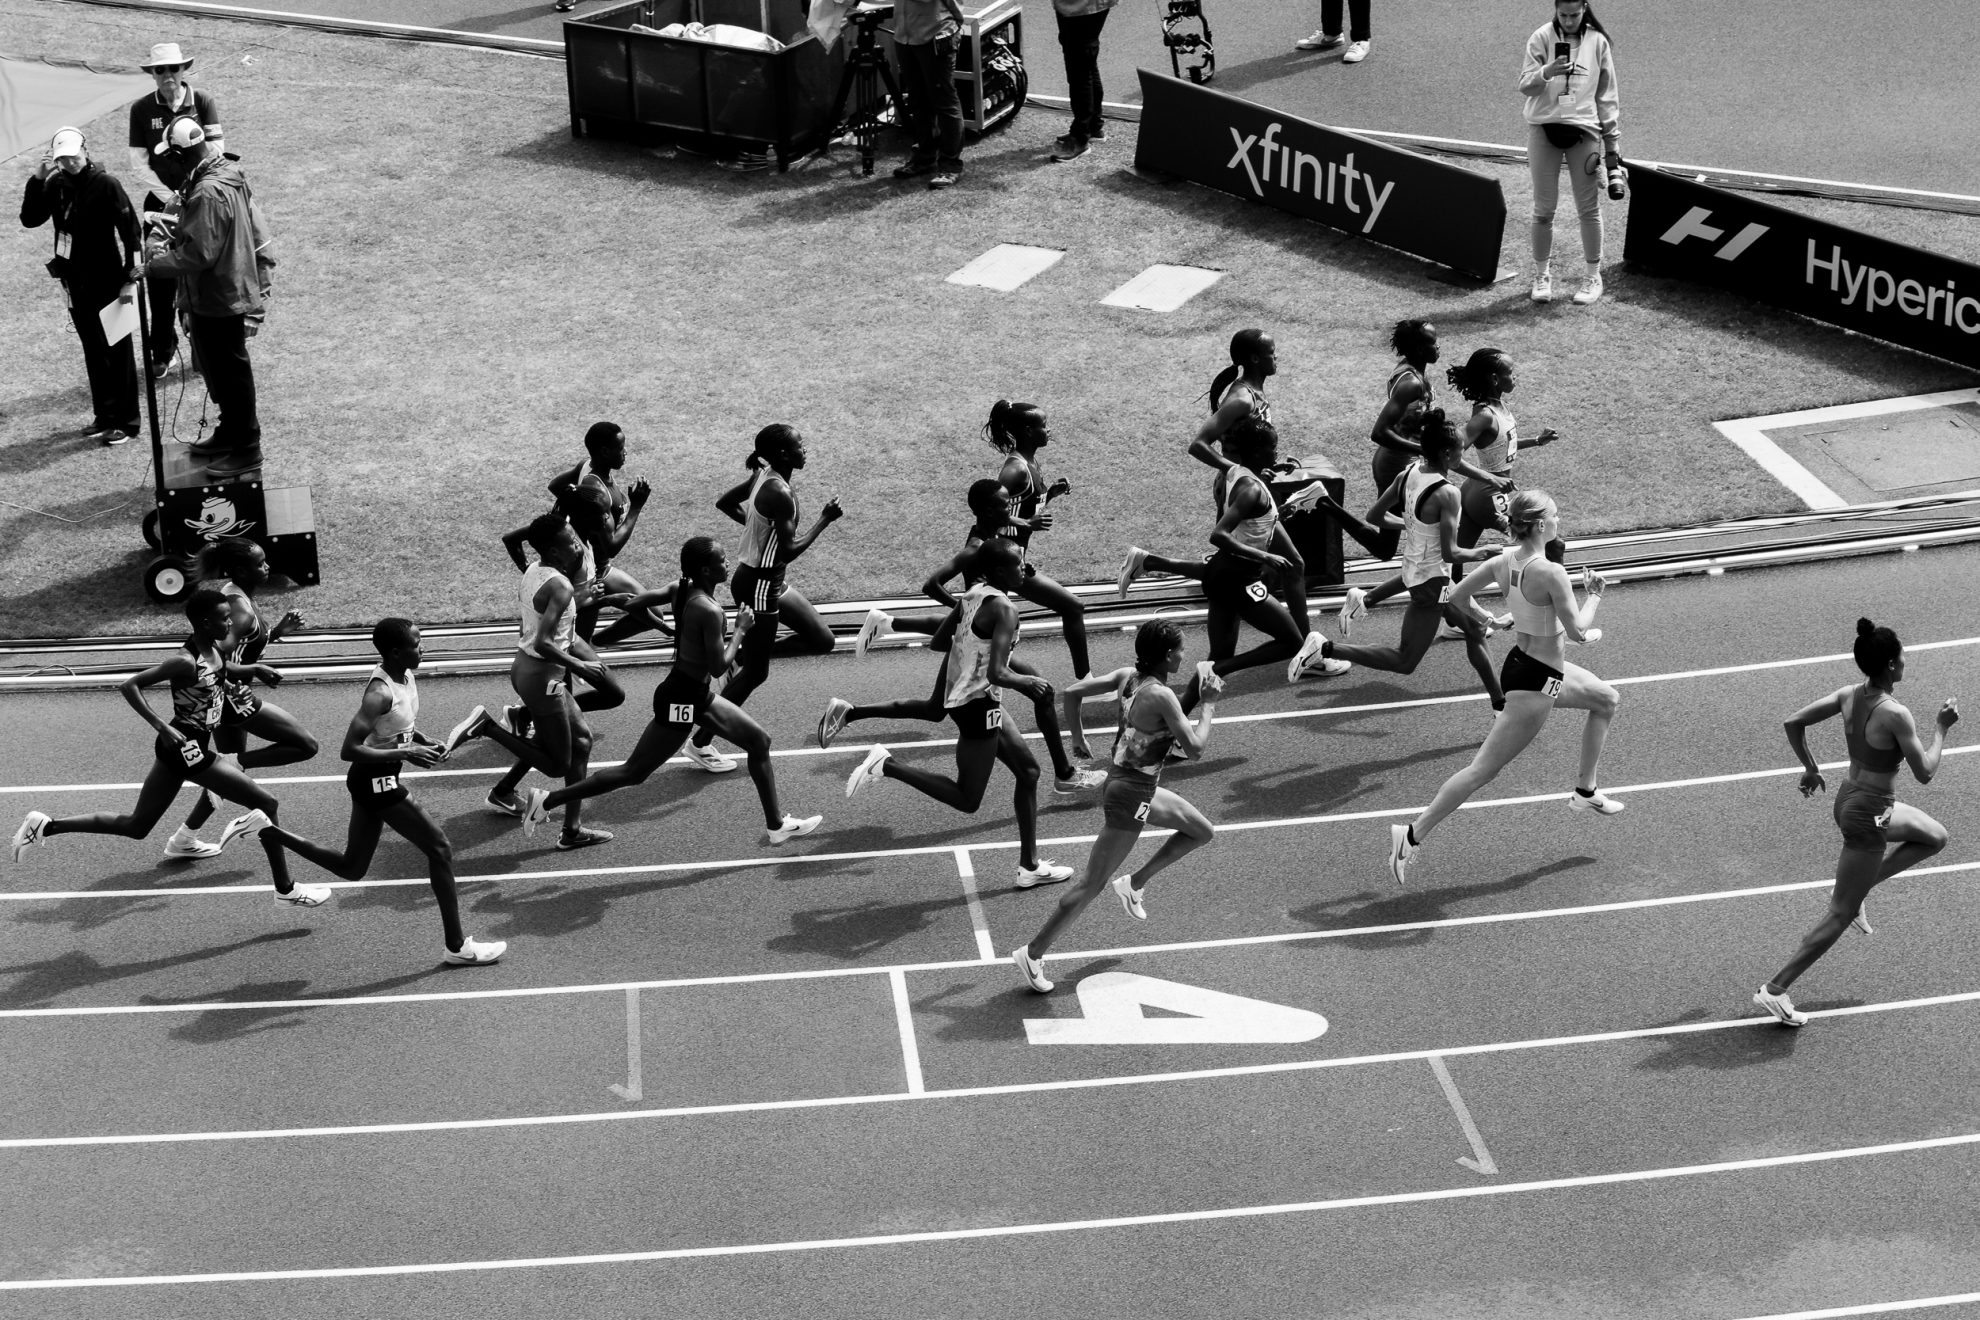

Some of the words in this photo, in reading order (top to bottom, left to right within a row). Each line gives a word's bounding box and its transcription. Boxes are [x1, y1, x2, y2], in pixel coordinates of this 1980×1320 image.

[1226, 122, 1396, 234] xfinity
[1806, 238, 1980, 334] Hyperic
[1250, 584, 1266, 598] 6
[1548, 680, 1562, 697] 19
[674, 705, 690, 722] 16
[987, 710, 1002, 727] 17
[183, 743, 201, 762] 13
[376, 777, 393, 793] 15
[1022, 971, 1329, 1045] 4
